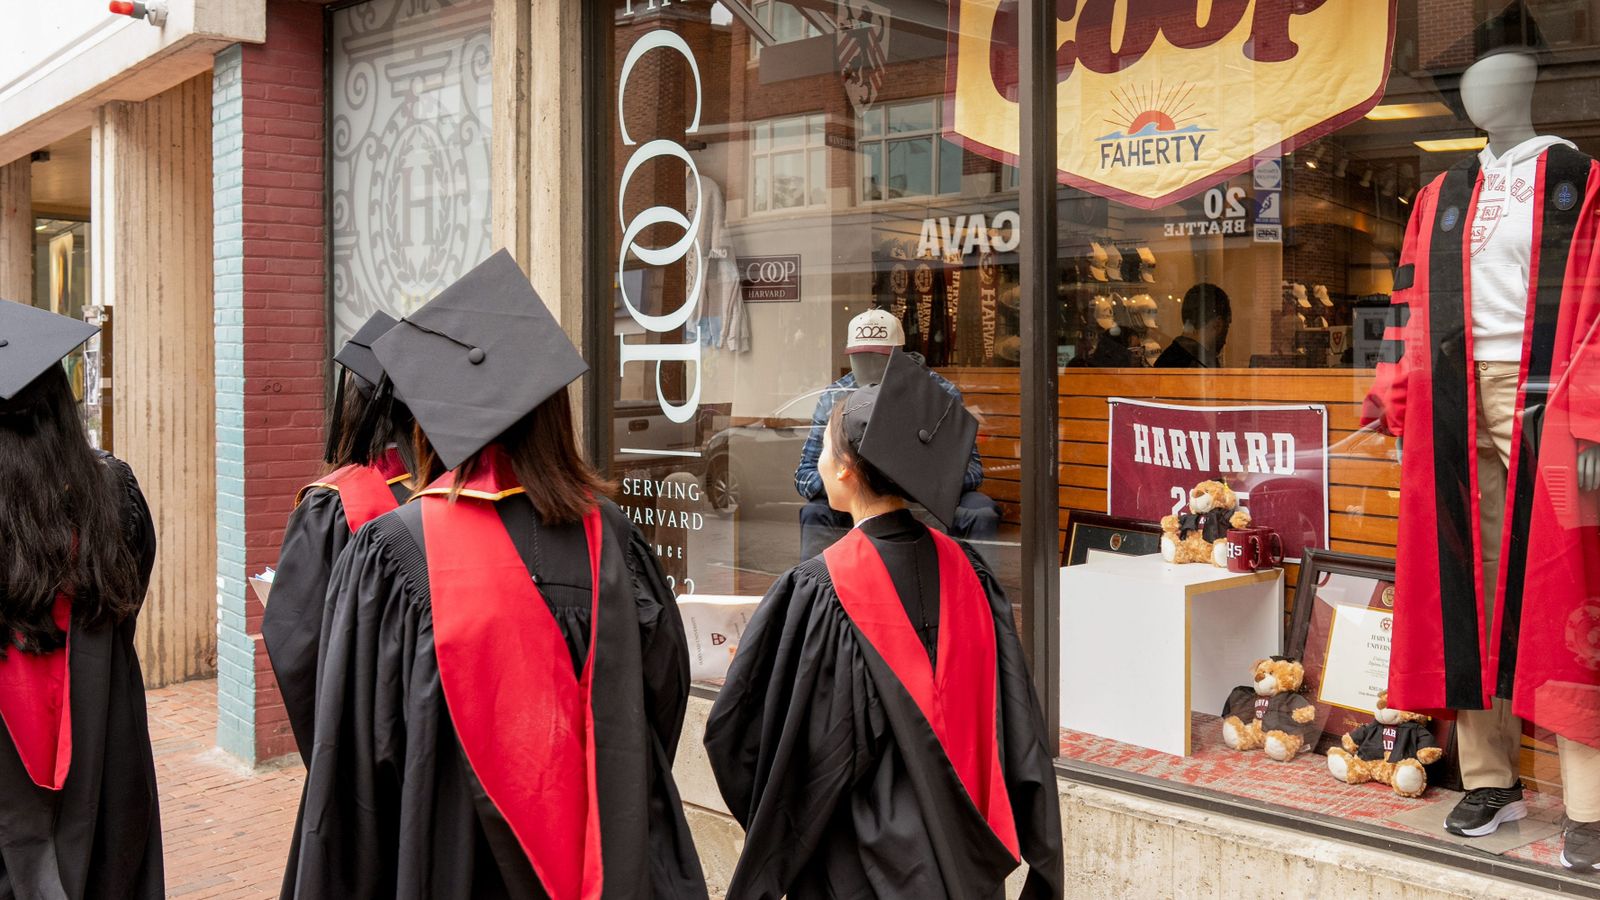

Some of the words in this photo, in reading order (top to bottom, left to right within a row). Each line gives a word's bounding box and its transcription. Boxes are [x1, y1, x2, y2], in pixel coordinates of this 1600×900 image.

[1100, 134, 1205, 169] FAHERTY
[619, 29, 701, 423] COOP
[746, 261, 795, 283] COOP
[748, 290, 786, 298] HARVARD
[855, 326, 888, 339] 2025
[981, 288, 996, 358] HARVARD
[1133, 423, 1296, 475] HARVARD
[623, 478, 700, 501] SERVING
[656, 544, 683, 559] NCE
